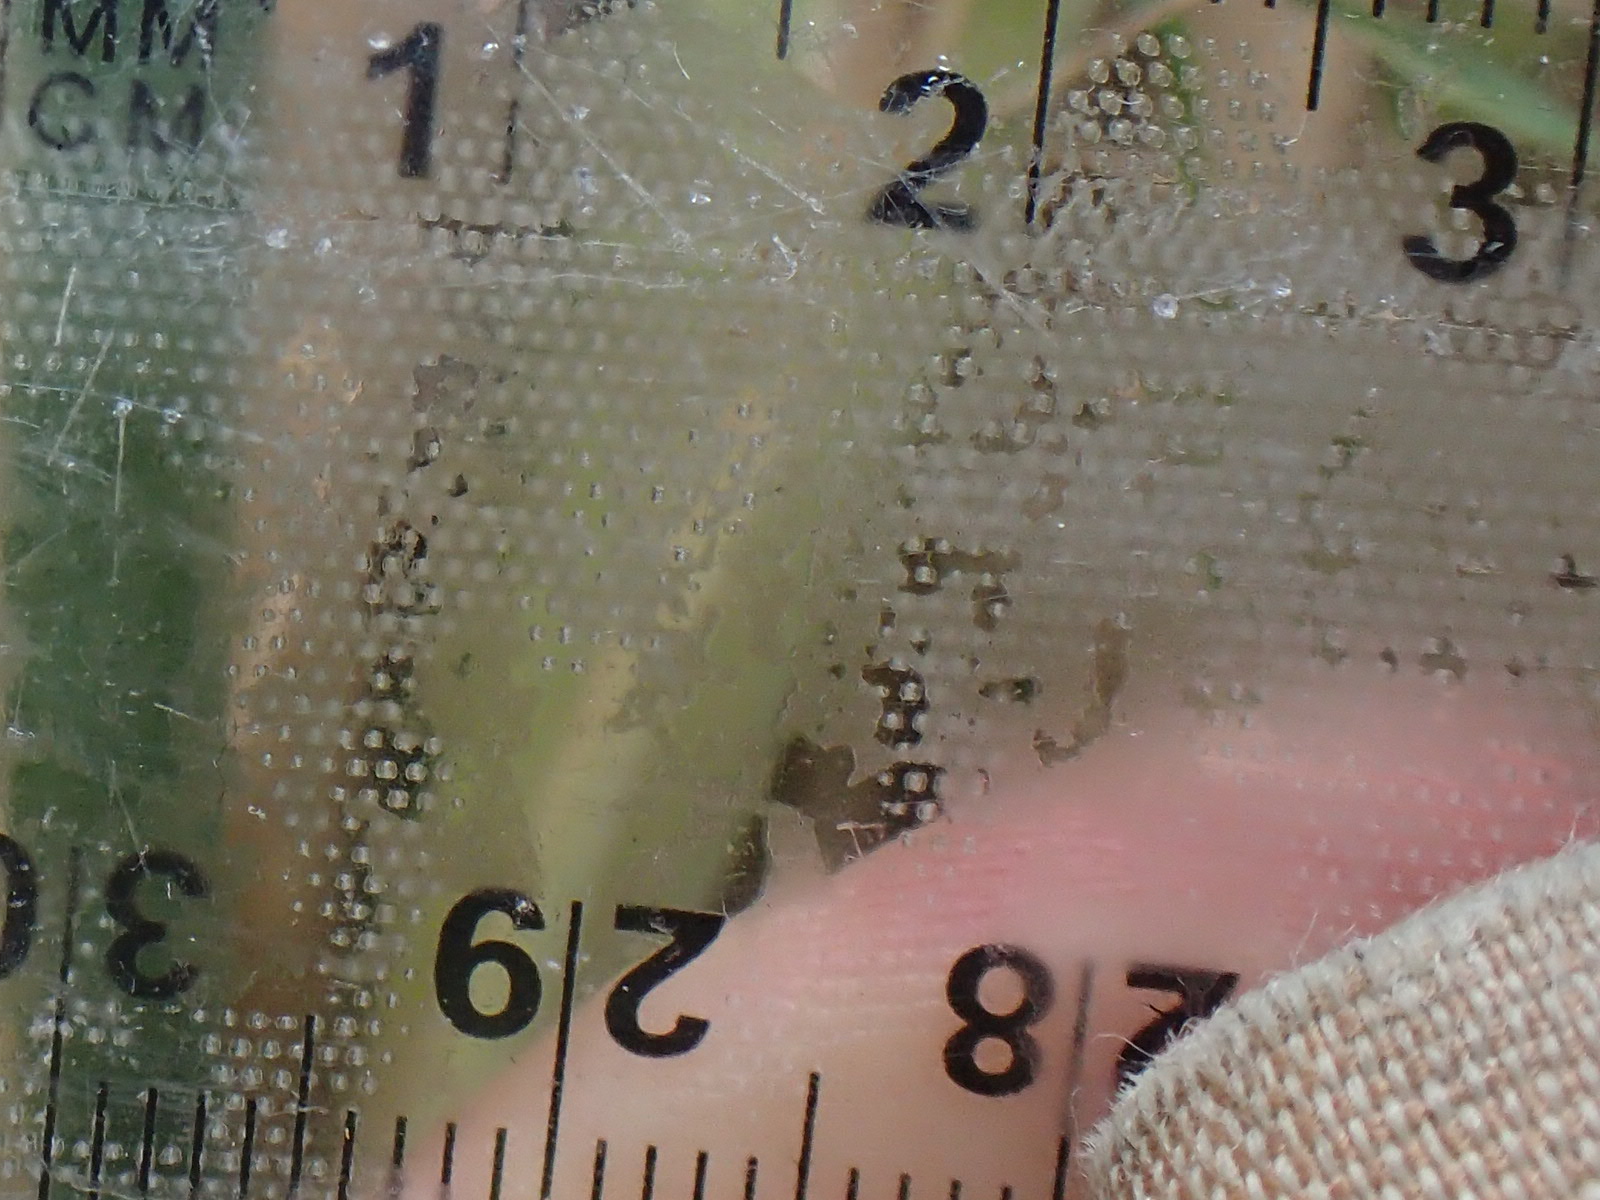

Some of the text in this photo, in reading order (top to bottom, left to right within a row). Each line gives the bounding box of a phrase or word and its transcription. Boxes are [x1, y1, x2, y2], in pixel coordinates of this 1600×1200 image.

[28, 71, 208, 157] CM
[366, 21, 443, 178] 1
[867, 68, 989, 232] 2
[1403, 121, 1518, 284] 3
